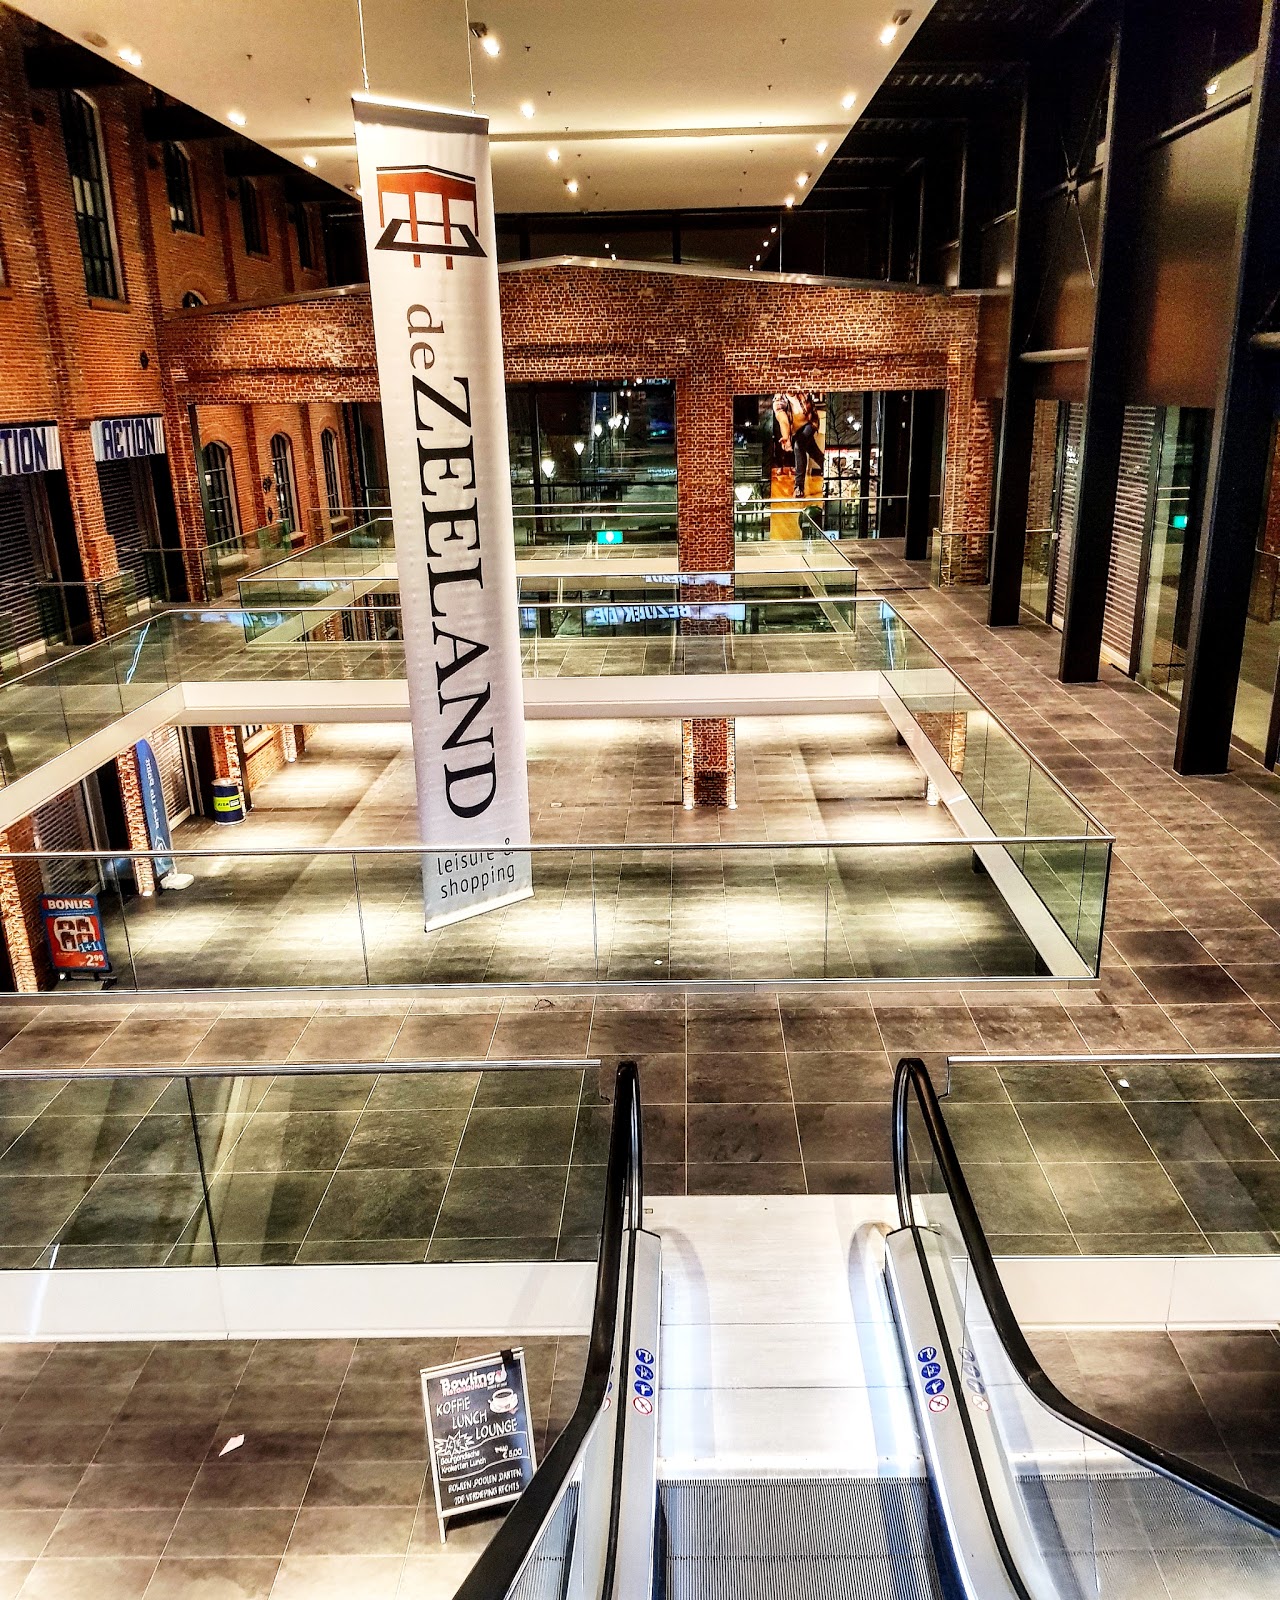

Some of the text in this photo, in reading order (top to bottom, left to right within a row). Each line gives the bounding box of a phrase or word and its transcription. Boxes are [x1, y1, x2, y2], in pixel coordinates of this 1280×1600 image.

[101, 418, 155, 459] ACTION
[440, 864, 515, 899] shopping
[47, 899, 91, 910] BONUS
[439, 1371, 495, 1393] Bowling
[436, 1396, 471, 1417] KOFFIE
[452, 1409, 488, 1430] LUNCH
[475, 1418, 517, 1440] LOUNGE
